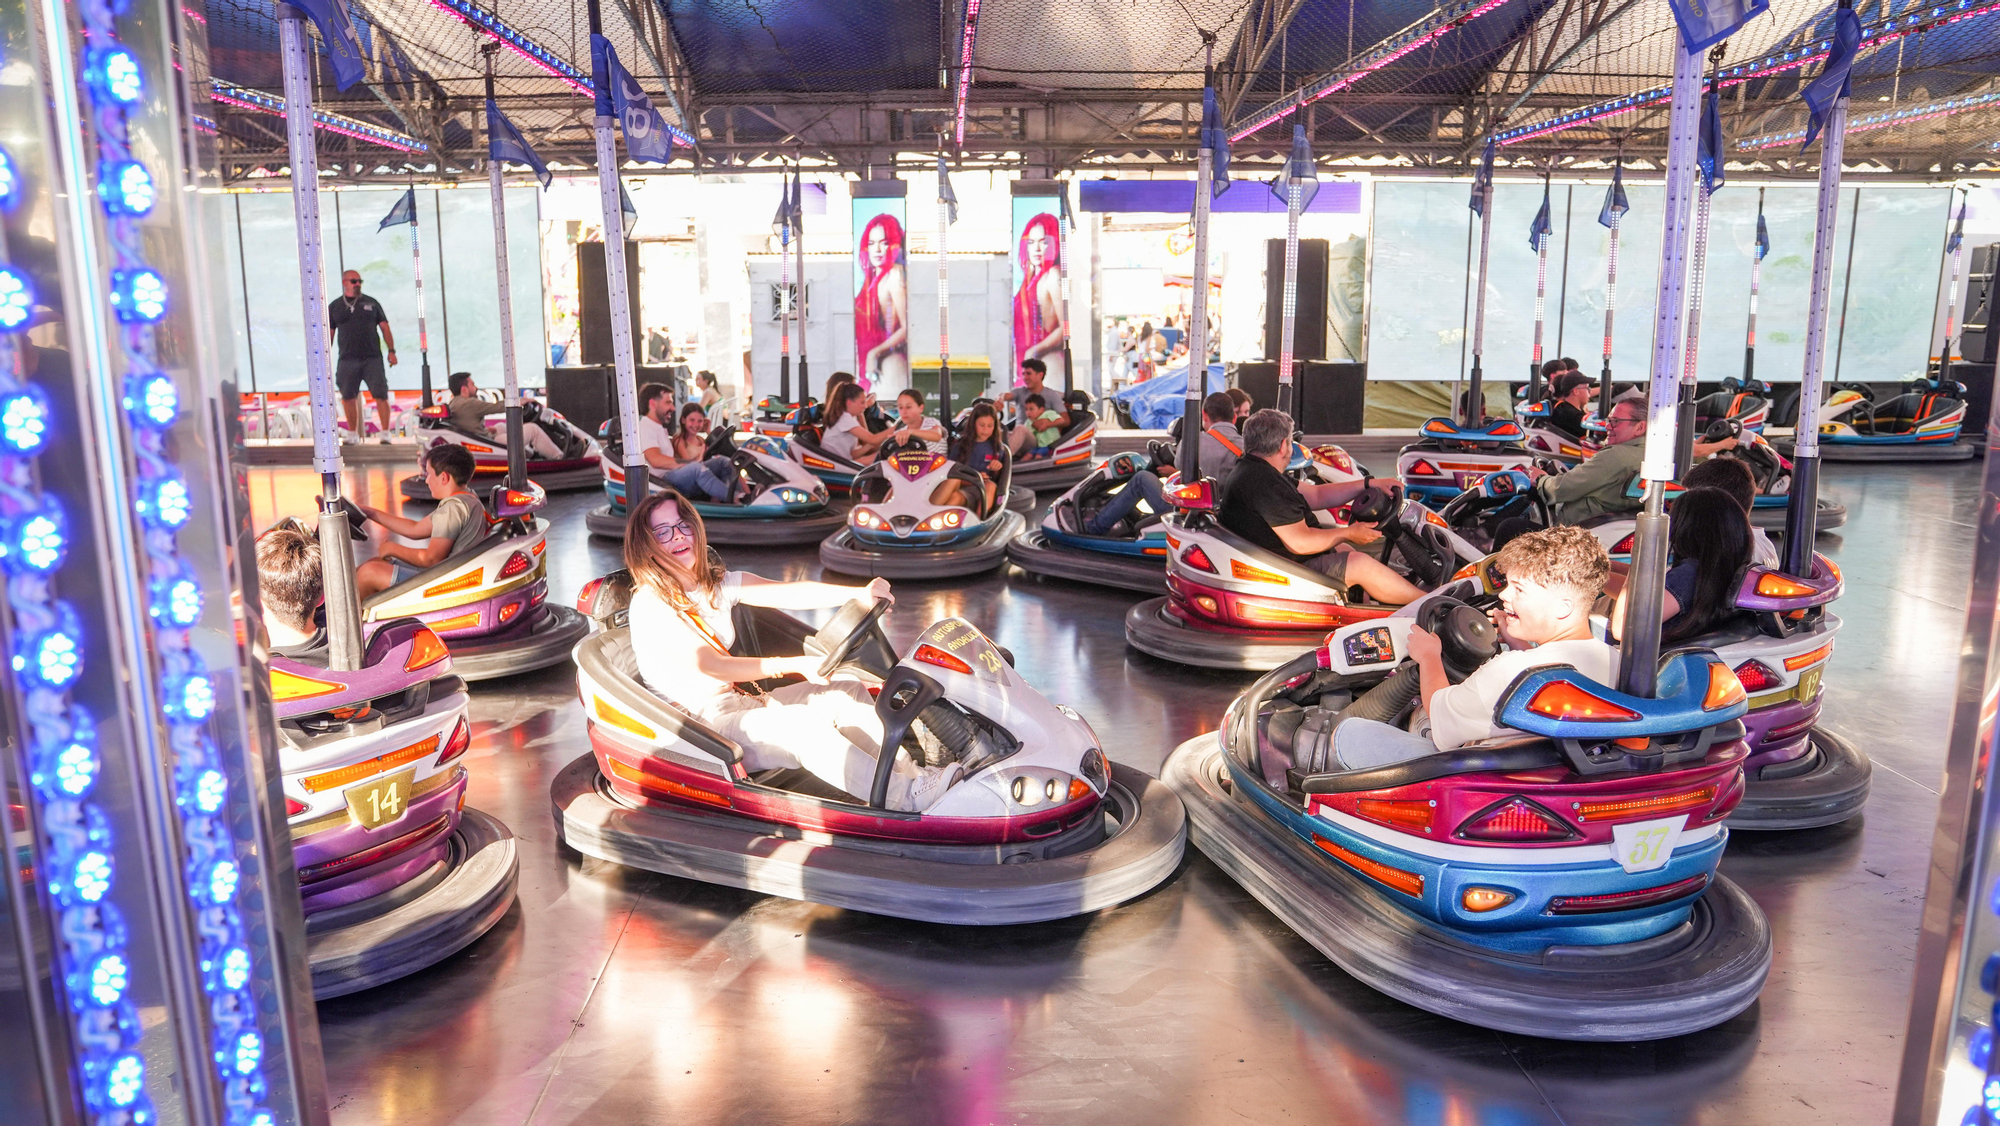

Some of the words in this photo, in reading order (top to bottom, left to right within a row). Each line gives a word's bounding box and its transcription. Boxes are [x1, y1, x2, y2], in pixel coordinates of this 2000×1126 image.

[908, 464, 920, 475] 19
[1462, 475, 1477, 490] 17
[979, 649, 1003, 673] 28
[1805, 671, 1819, 701] 12
[366, 782, 402, 823] 14
[1629, 825, 1670, 865] 37
